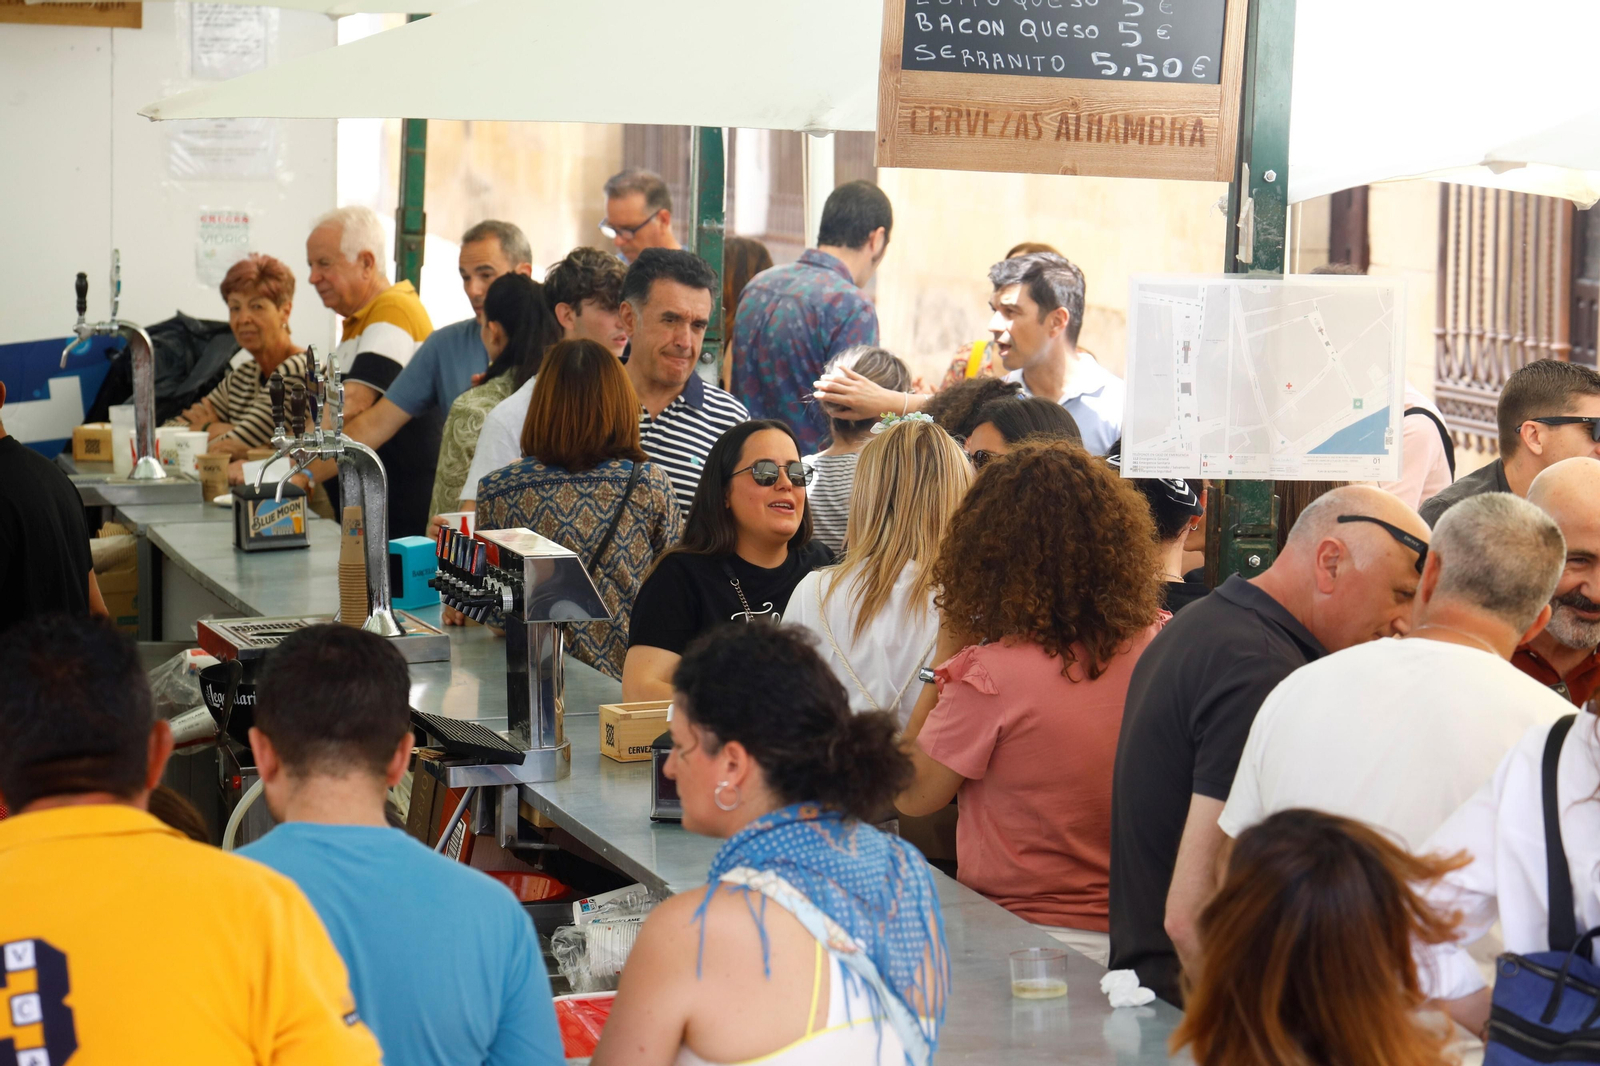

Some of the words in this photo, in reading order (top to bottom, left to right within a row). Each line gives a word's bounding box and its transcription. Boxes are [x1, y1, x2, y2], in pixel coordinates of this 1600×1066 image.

[915, 12, 1005, 36] BACON
[1020, 18, 1100, 42] QUESO
[1118, 21, 1142, 48] 5
[1156, 24, 1173, 40] €
[914, 44, 1066, 72] SERRANITO
[909, 105, 1044, 141] CERVEZAS
[1055, 113, 1207, 148] ALHAMBRA
[1372, 457, 1381, 465] 01
[252, 512, 275, 531] BLUE
[277, 502, 301, 518] MOON
